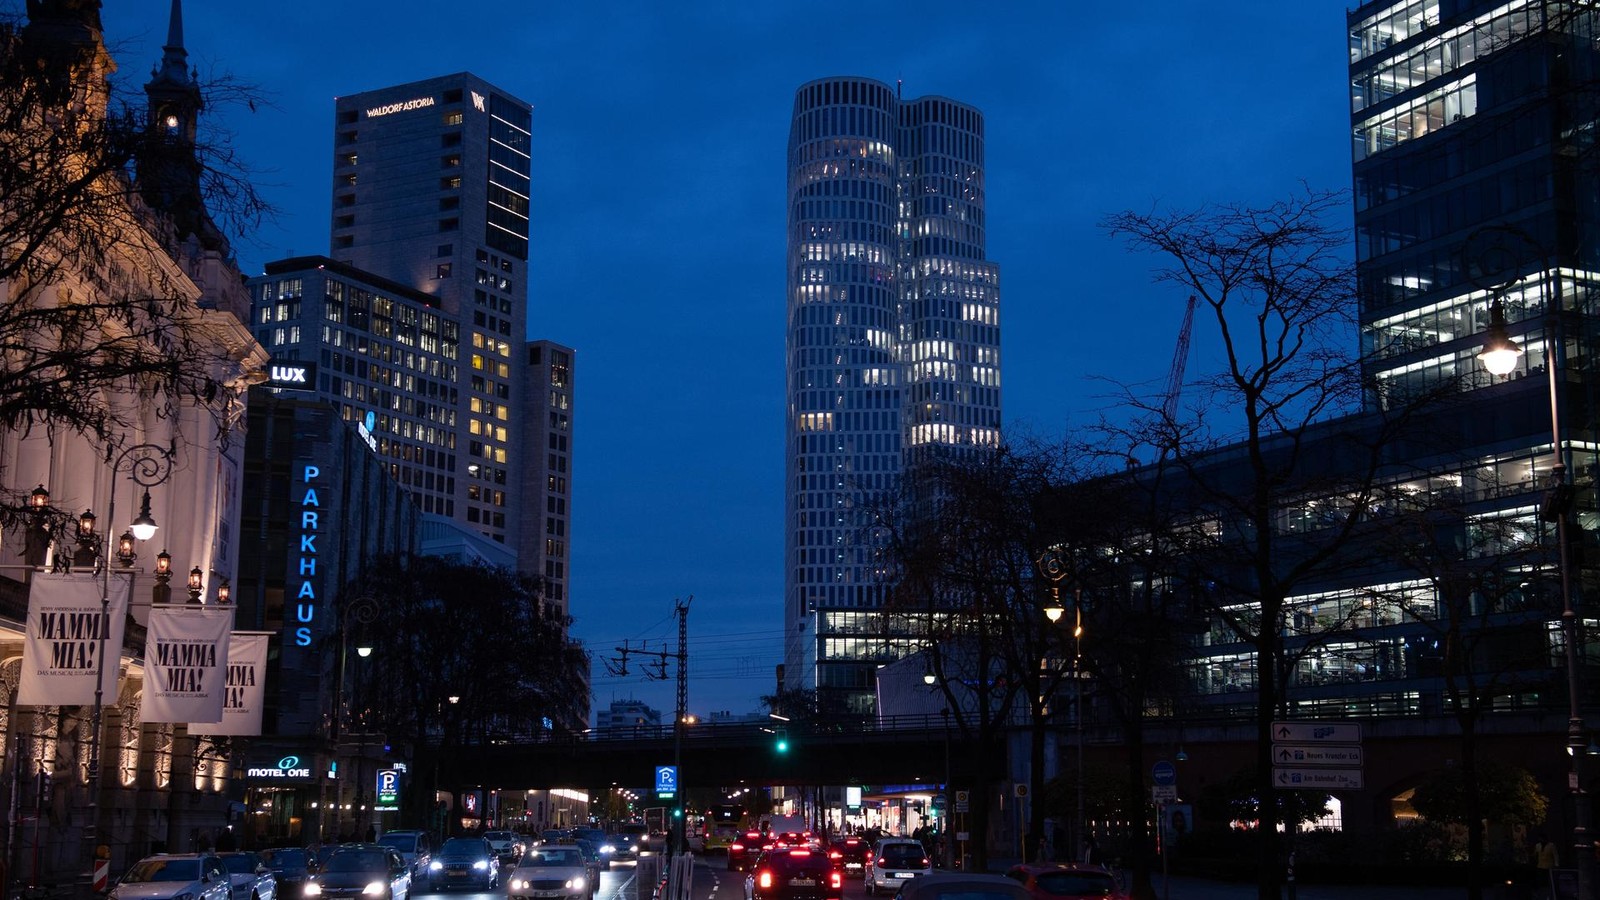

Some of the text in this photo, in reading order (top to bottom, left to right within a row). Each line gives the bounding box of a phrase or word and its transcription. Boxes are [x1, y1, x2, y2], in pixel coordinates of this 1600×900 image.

[366, 97, 434, 117] WALDORF ASTORIA
[272, 366, 305, 382] LUX
[296, 465, 319, 646] PARKHAUS
[50, 642, 96, 669] MIA!
[154, 643, 216, 667] MAMMA
[165, 668, 203, 692] MIA!
[225, 665, 256, 687] MMA
[223, 687, 244, 708] IA!
[247, 768, 310, 778] MOTEL ONE
[383, 774, 395, 789] P
[662, 771, 670, 783] P
